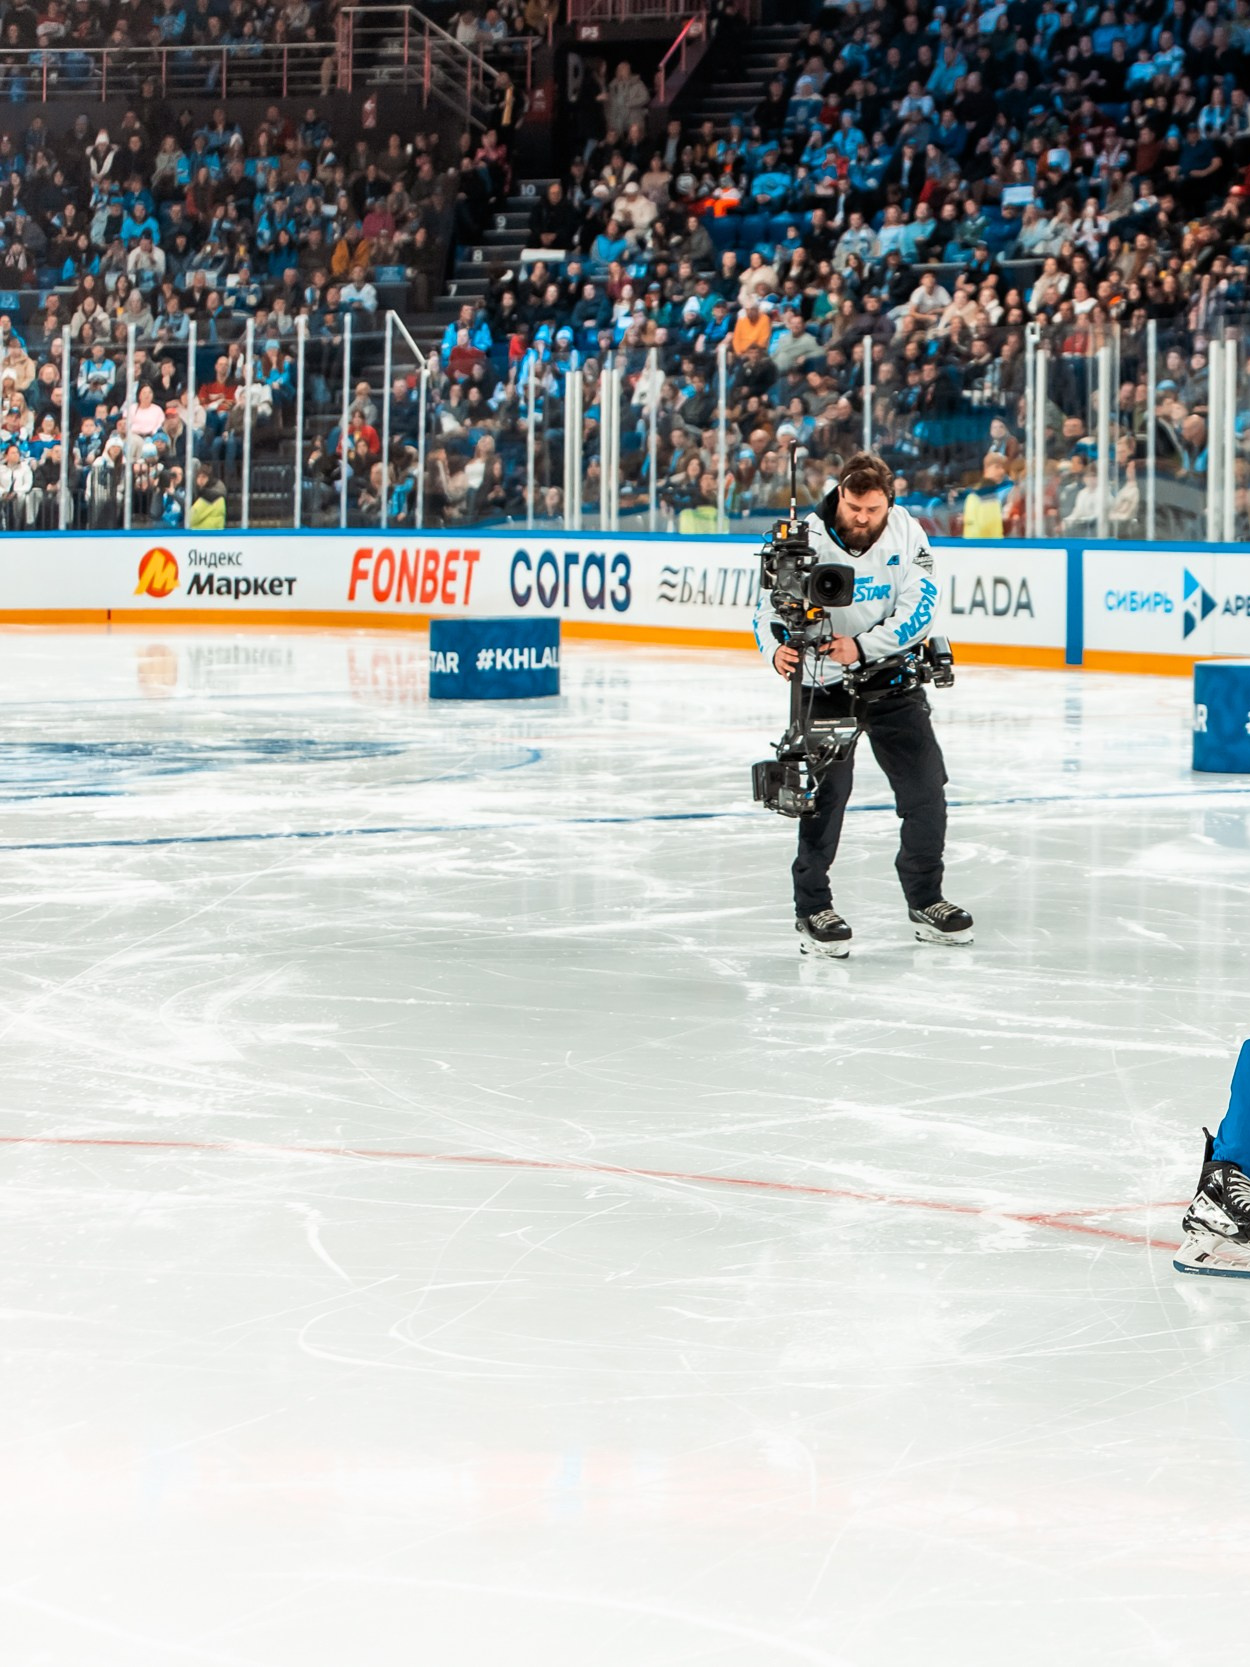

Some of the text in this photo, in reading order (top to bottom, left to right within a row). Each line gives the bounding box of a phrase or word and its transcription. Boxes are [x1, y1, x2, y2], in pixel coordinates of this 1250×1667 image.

[188, 549, 243, 569] Яндекс
[186, 572, 297, 600] Маркет
[347, 547, 481, 605] FONBET
[950, 575, 1035, 618] LADA
[1104, 589, 1175, 614] СИБИРЬ
